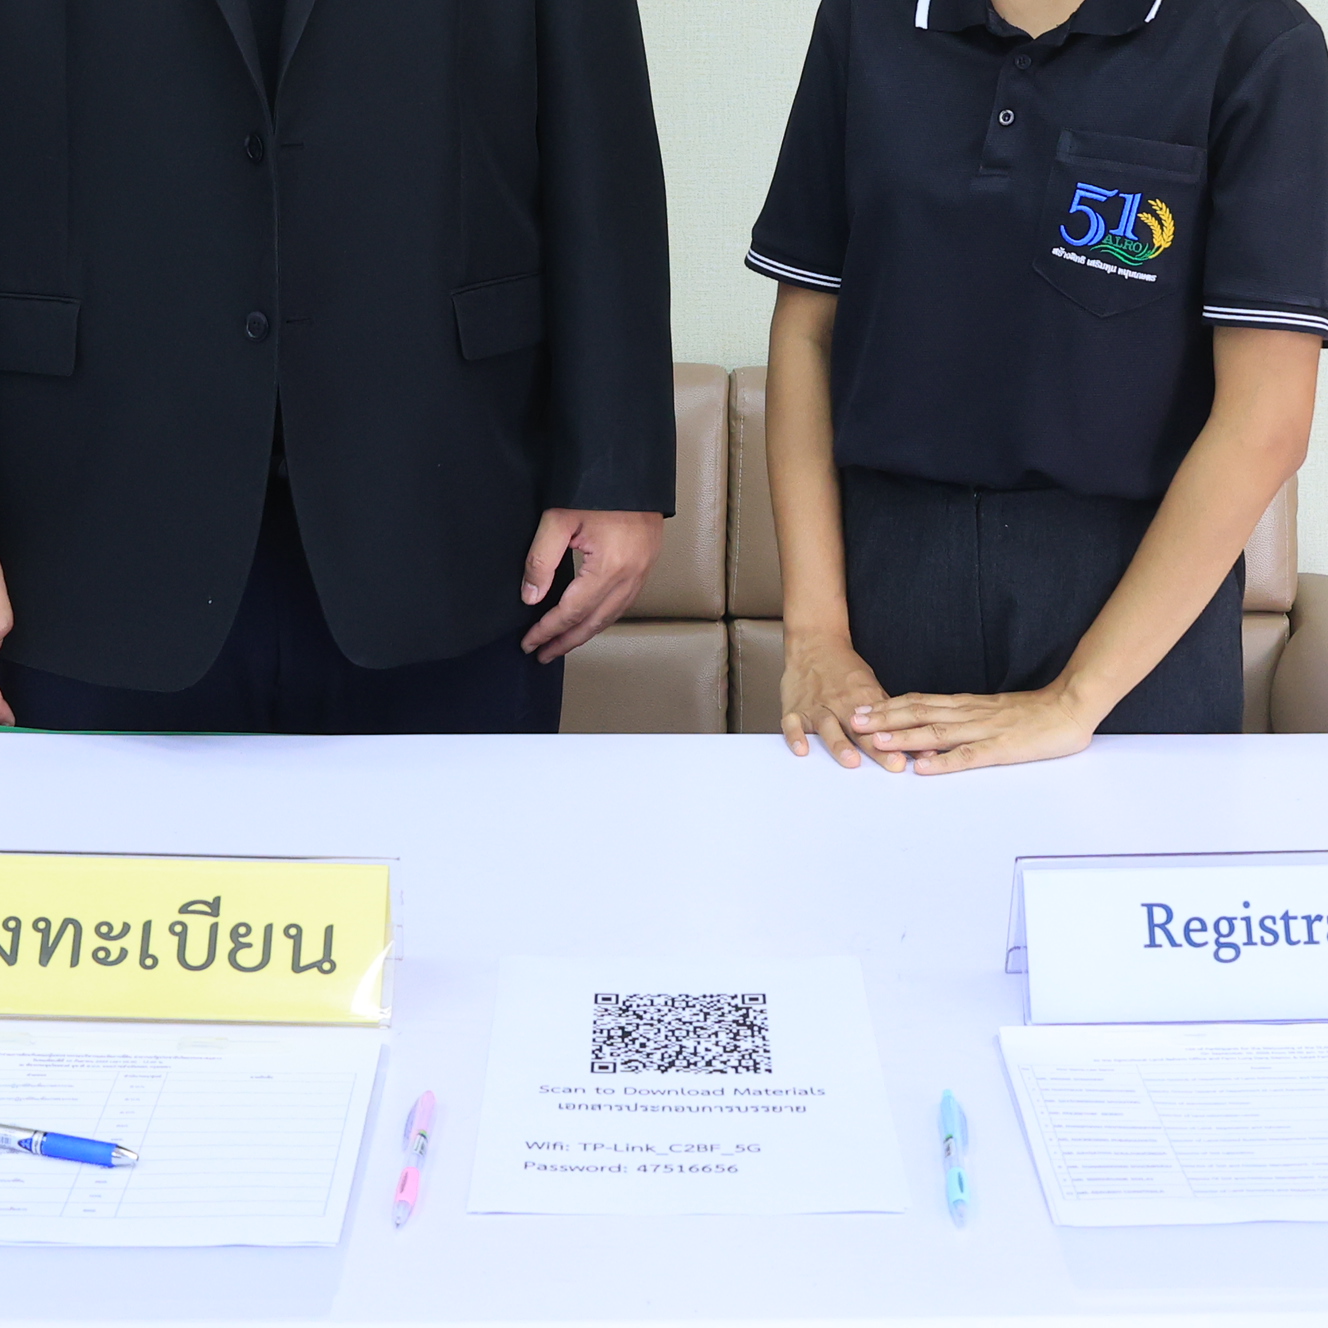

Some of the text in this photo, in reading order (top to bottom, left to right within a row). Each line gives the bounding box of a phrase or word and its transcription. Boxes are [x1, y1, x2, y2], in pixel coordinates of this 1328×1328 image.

[1059, 182, 1142, 246] 51
[1102, 234, 1143, 253] ALRO
[539, 1084, 826, 1096] Scan to Download Materials
[558, 1102, 807, 1113] เอกสารประกอบการบรรยาย
[525, 1141, 571, 1151] Wifi:
[523, 1161, 739, 1173] Password: 47516656
